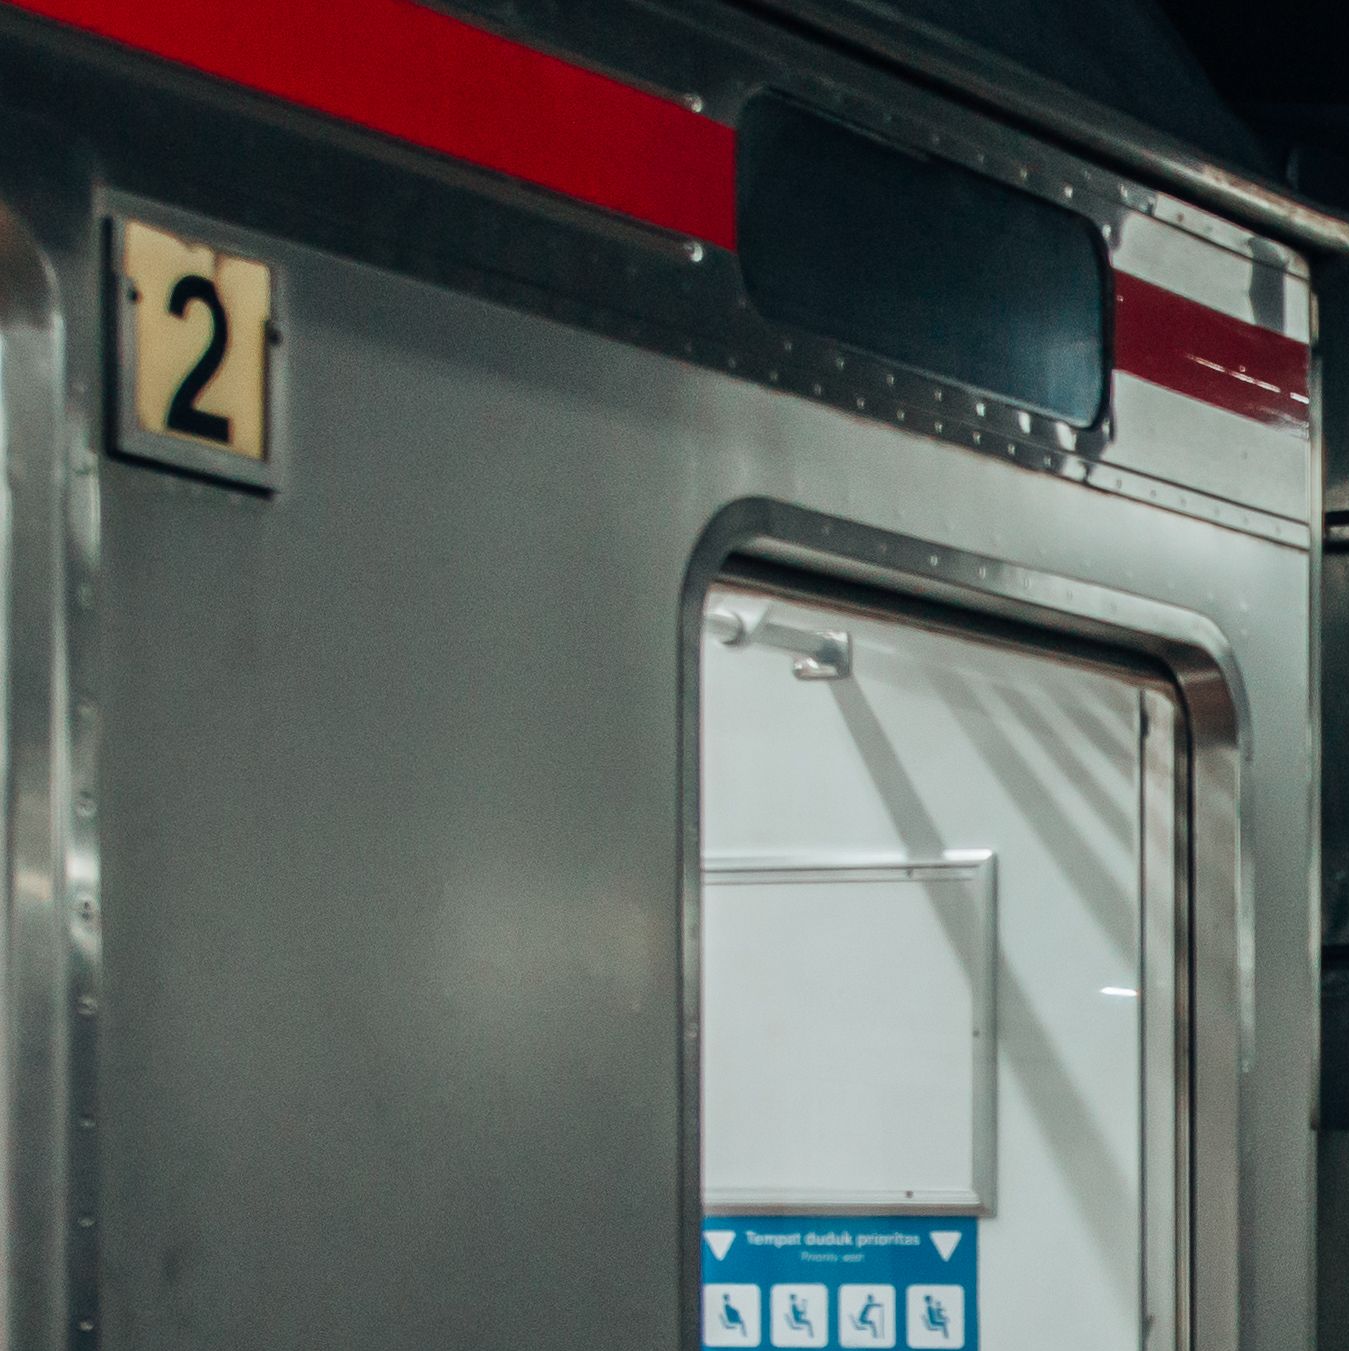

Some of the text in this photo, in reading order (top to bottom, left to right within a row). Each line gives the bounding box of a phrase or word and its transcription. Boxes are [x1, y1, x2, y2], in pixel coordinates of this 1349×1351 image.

[165, 274, 230, 445] 2
[745, 1230, 921, 1248] Tempat duduk prioritas
